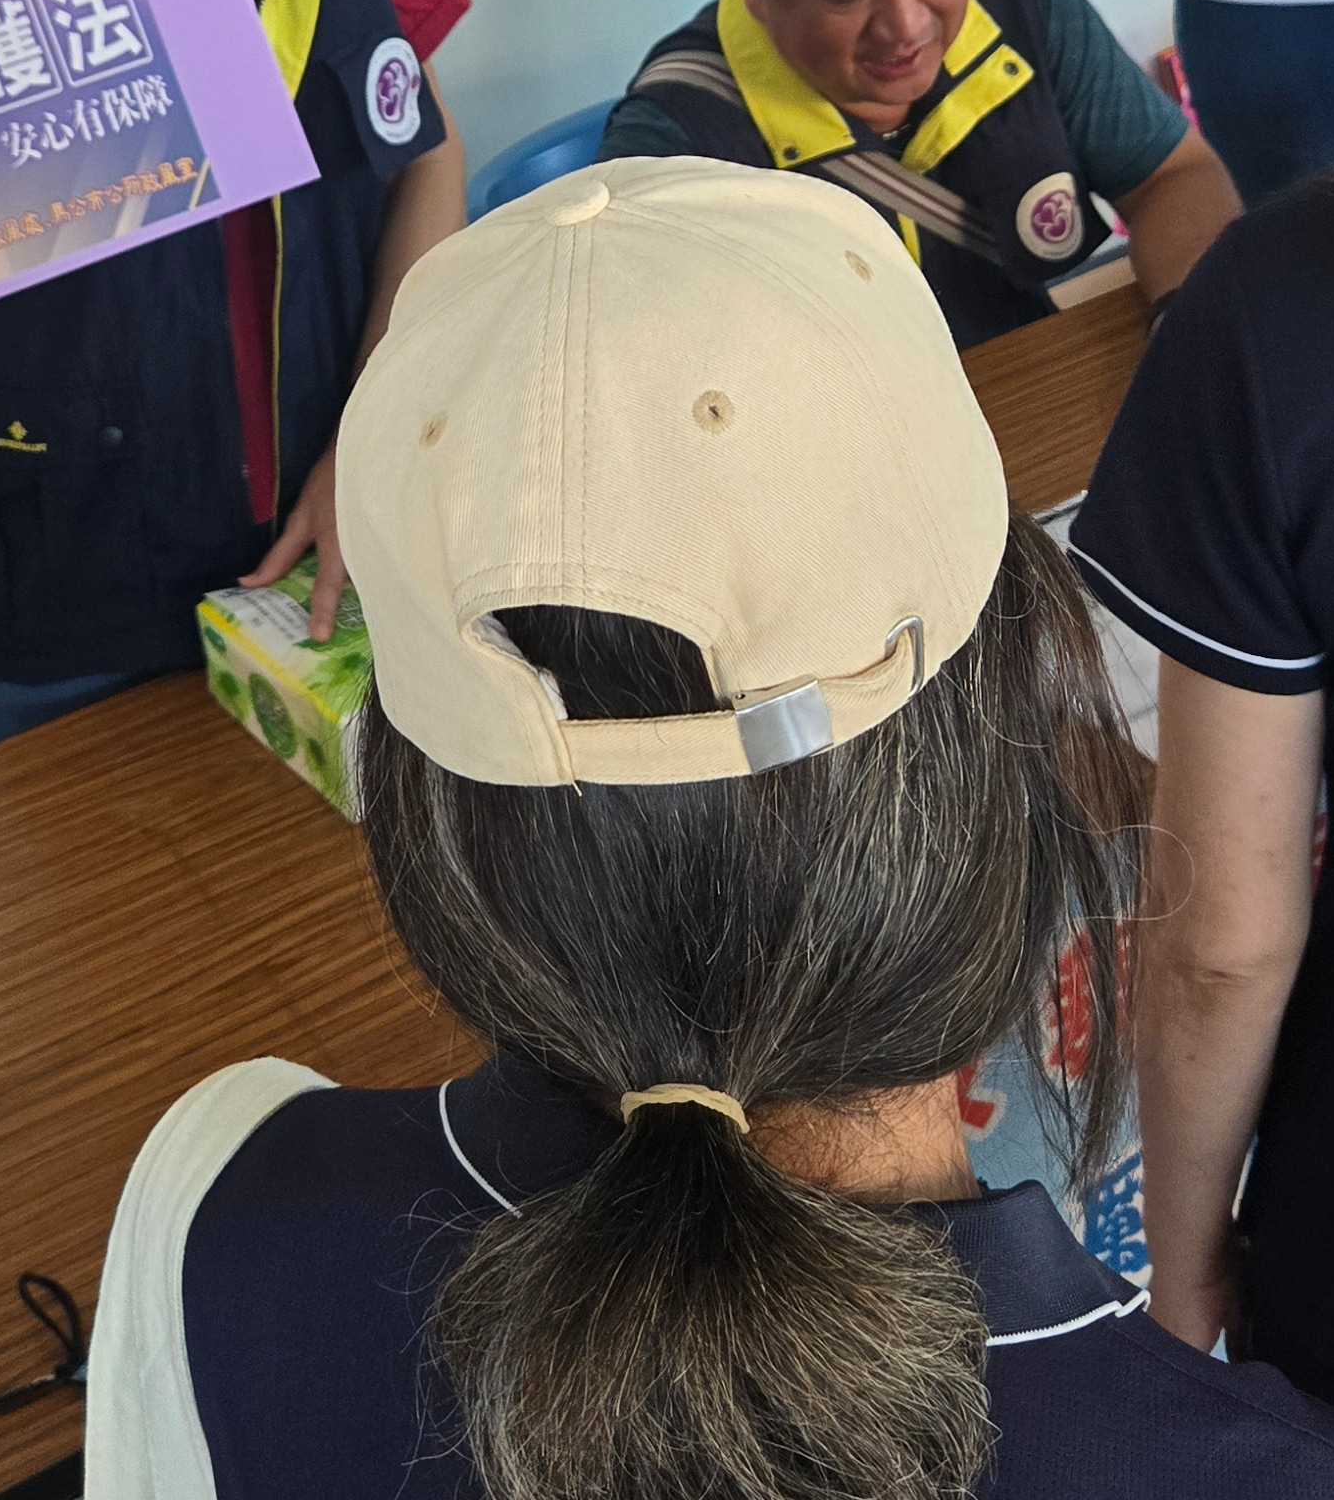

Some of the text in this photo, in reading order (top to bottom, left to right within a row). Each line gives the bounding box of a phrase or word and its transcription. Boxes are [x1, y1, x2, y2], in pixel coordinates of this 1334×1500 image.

[0, 72, 174, 170] 安心有保障
